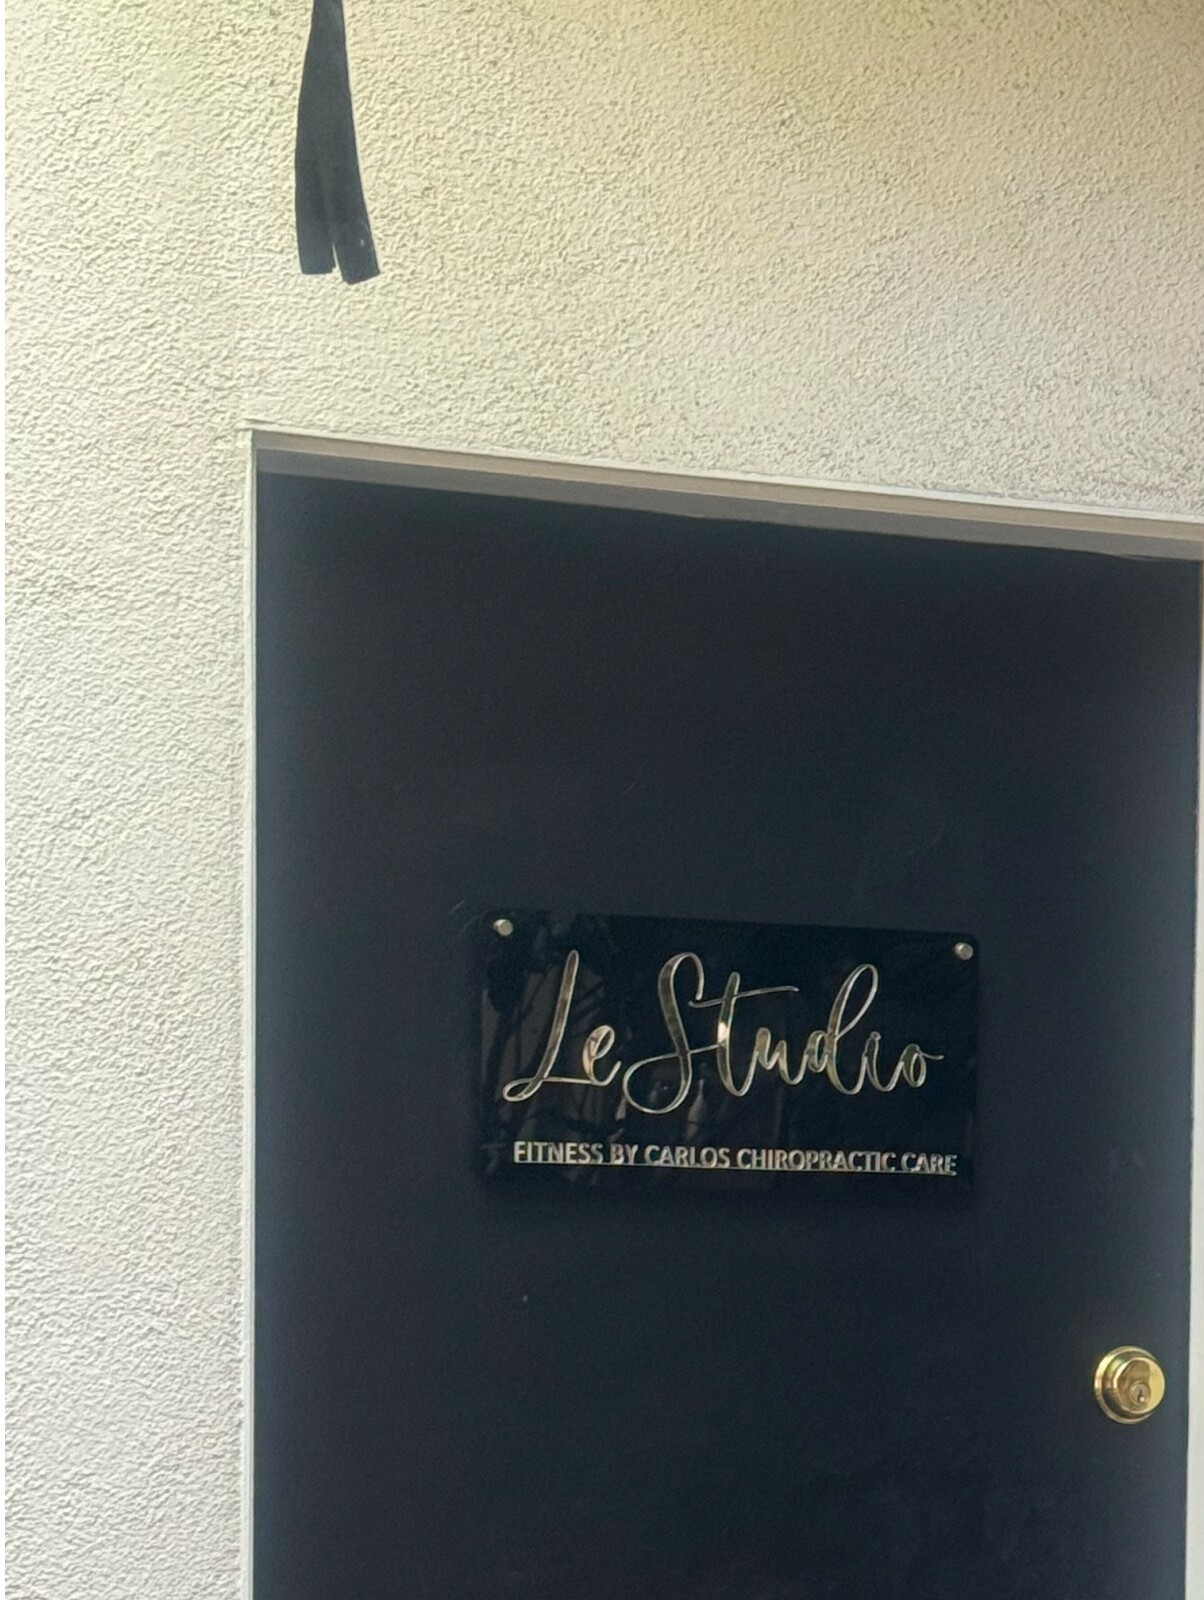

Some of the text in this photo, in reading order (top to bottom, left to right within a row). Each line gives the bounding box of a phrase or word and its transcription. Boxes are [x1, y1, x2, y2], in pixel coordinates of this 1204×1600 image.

[514, 1140, 958, 1177] FITNESS BY CARLOS CHIROPRACTIC CARE
